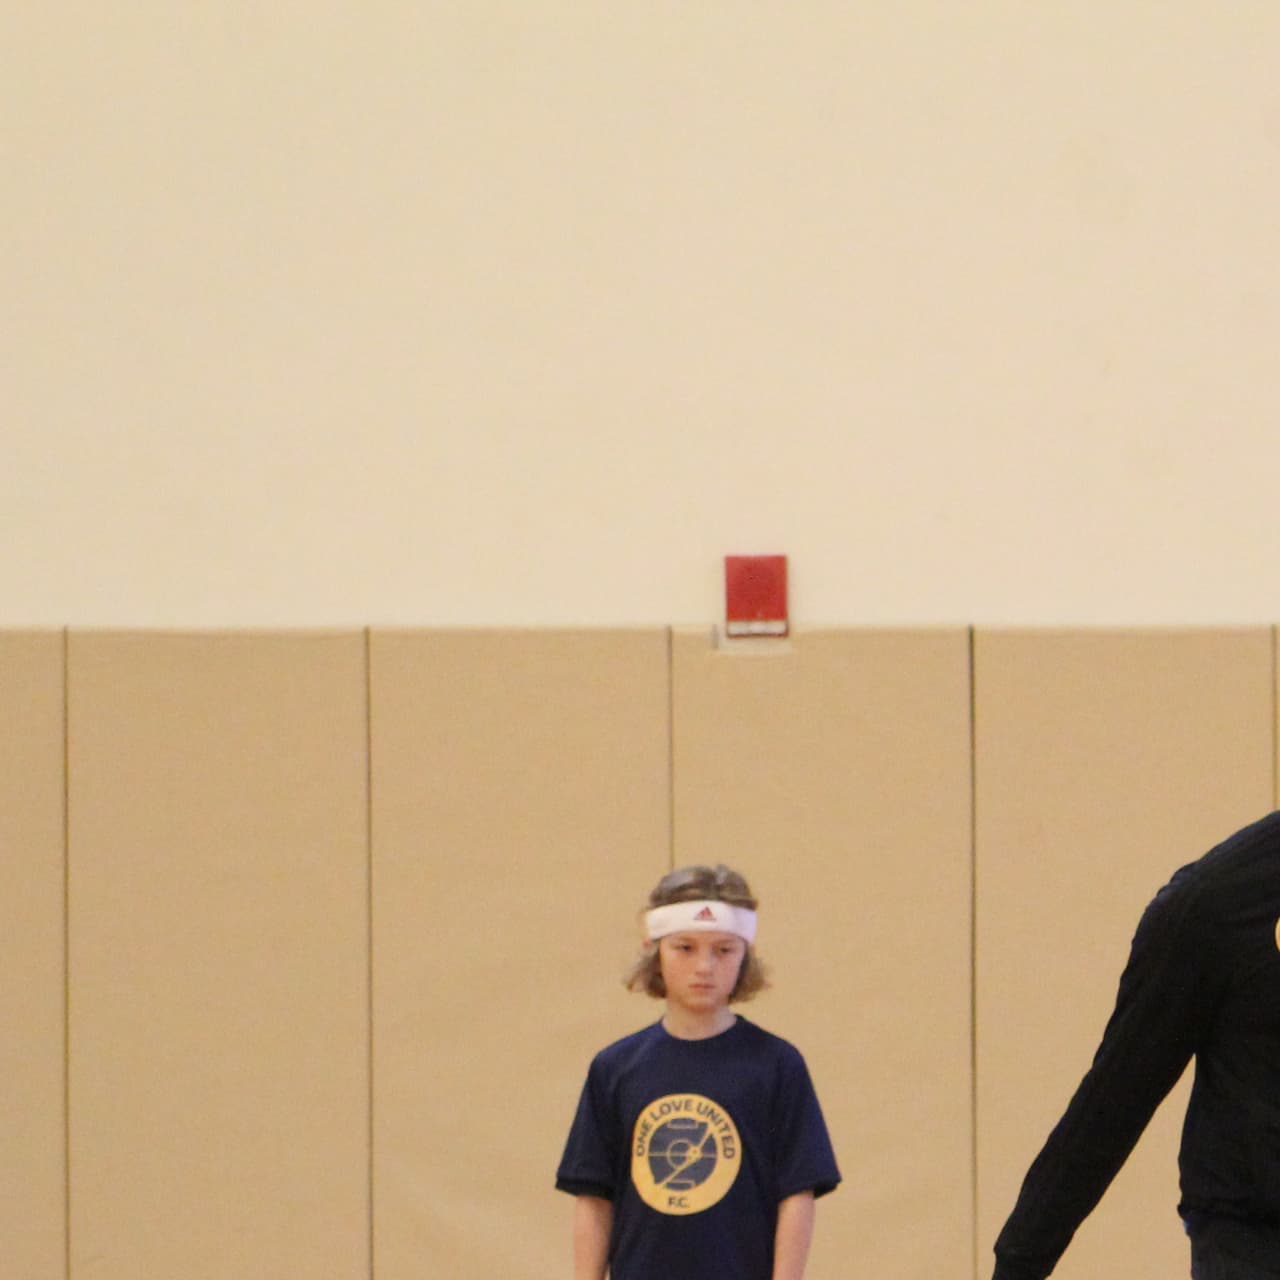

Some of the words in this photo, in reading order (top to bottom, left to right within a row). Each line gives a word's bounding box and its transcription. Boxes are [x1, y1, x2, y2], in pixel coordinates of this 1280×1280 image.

[636, 1119, 651, 1157] ONE
[650, 1099, 694, 1121] LOVE
[697, 1101, 736, 1160] UNITED
